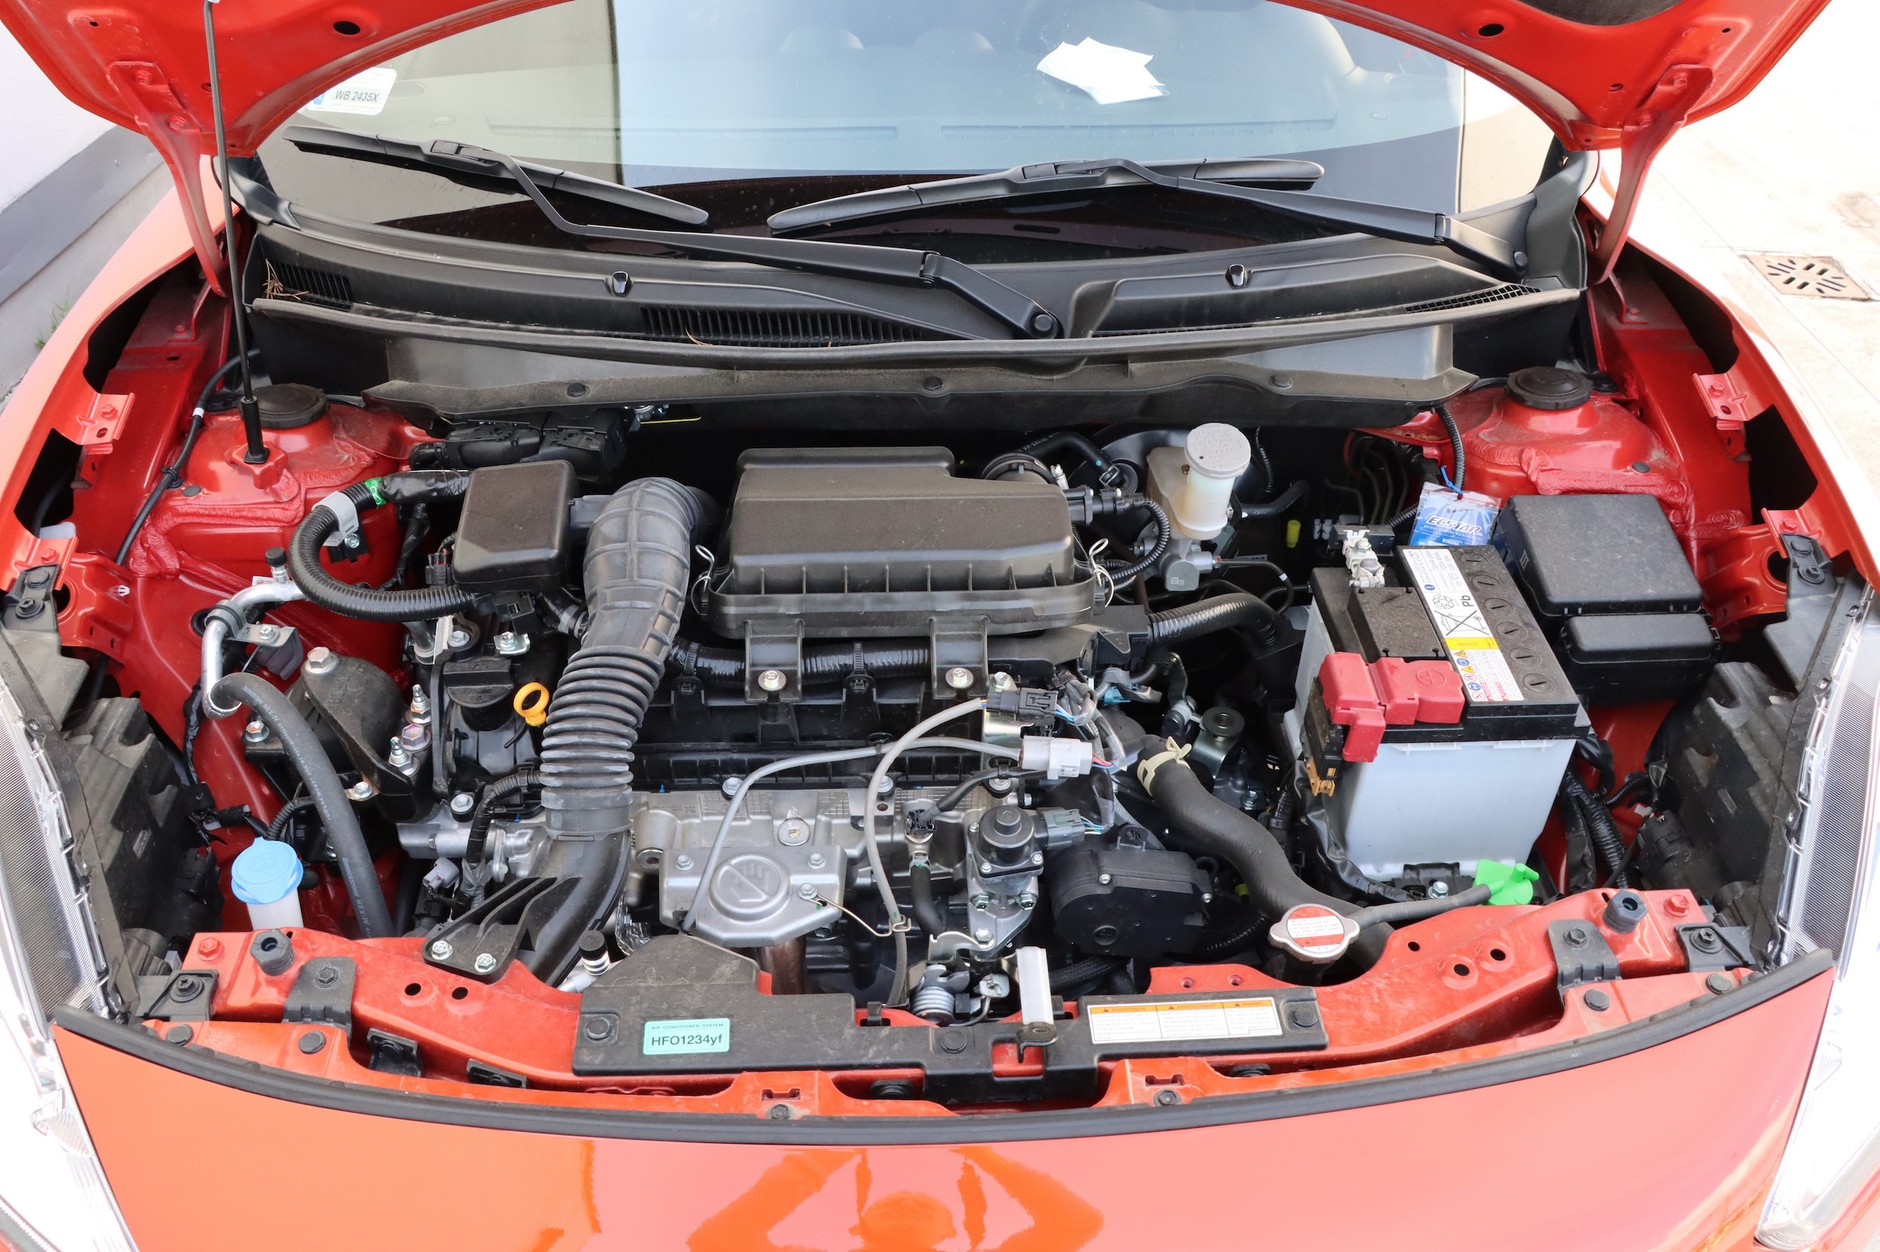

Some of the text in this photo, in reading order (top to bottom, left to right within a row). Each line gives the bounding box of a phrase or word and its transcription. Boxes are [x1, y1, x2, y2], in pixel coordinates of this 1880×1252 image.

[336, 90, 379, 102] WB 2435X
[1460, 595, 1474, 607] Pb
[651, 1034, 723, 1046] HFO1234yf
